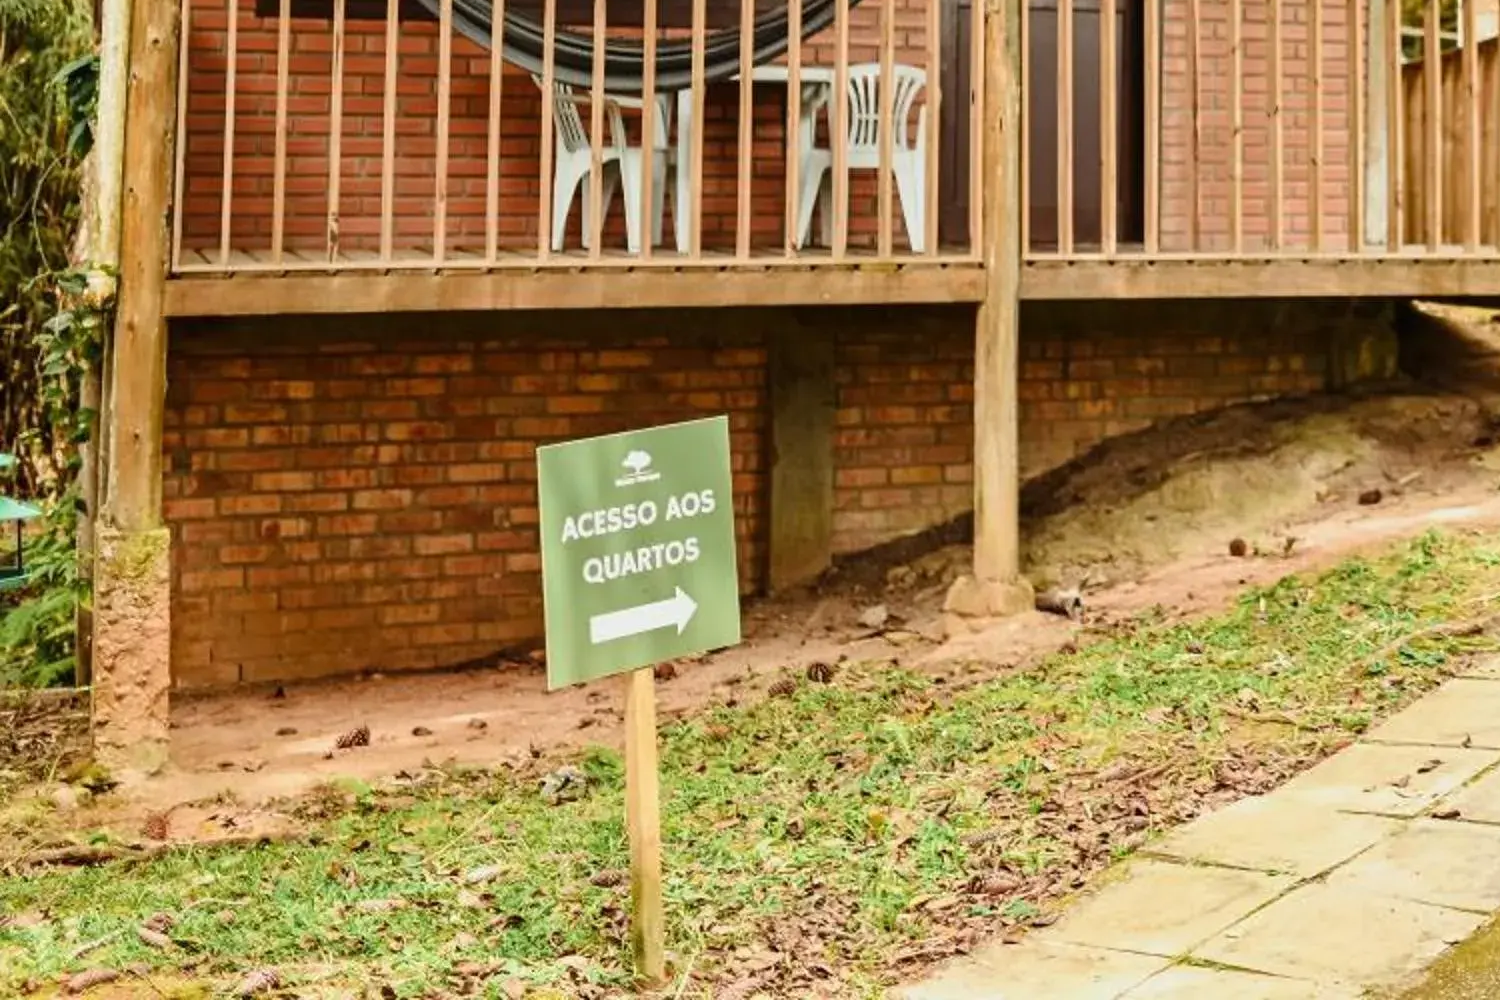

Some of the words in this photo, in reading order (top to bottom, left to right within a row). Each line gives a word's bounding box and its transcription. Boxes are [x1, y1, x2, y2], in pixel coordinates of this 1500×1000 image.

[562, 501, 657, 542] ACESSO
[666, 489, 715, 521] AOS
[583, 538, 700, 583] QUARTOS
